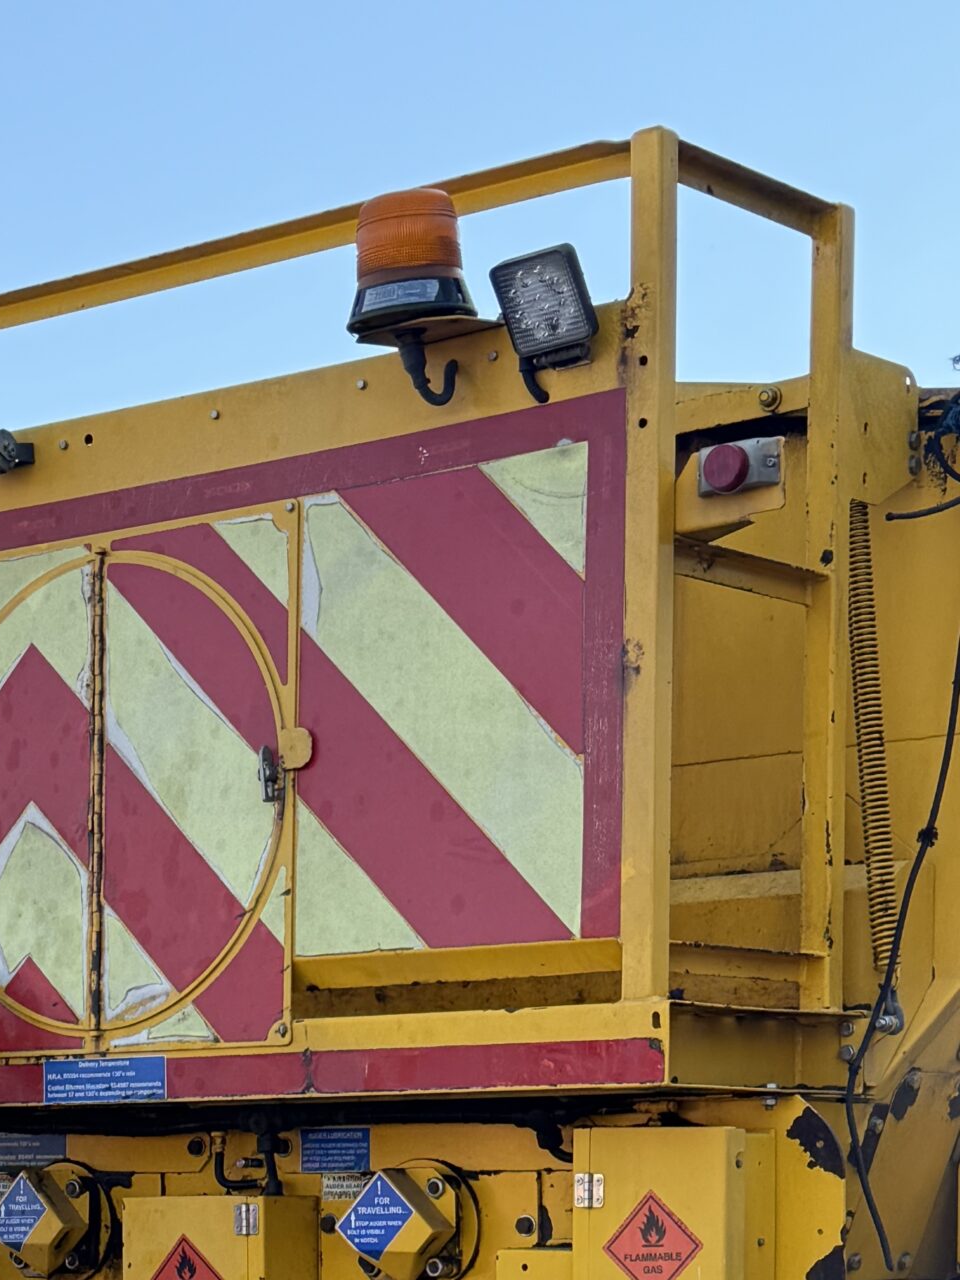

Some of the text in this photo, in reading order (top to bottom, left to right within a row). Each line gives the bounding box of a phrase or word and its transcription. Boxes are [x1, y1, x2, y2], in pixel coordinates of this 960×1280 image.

[374, 1197, 390, 1205] FOR
[624, 1252, 682, 1262] FLAMMABLE
[643, 1266, 663, 1274] GAS
